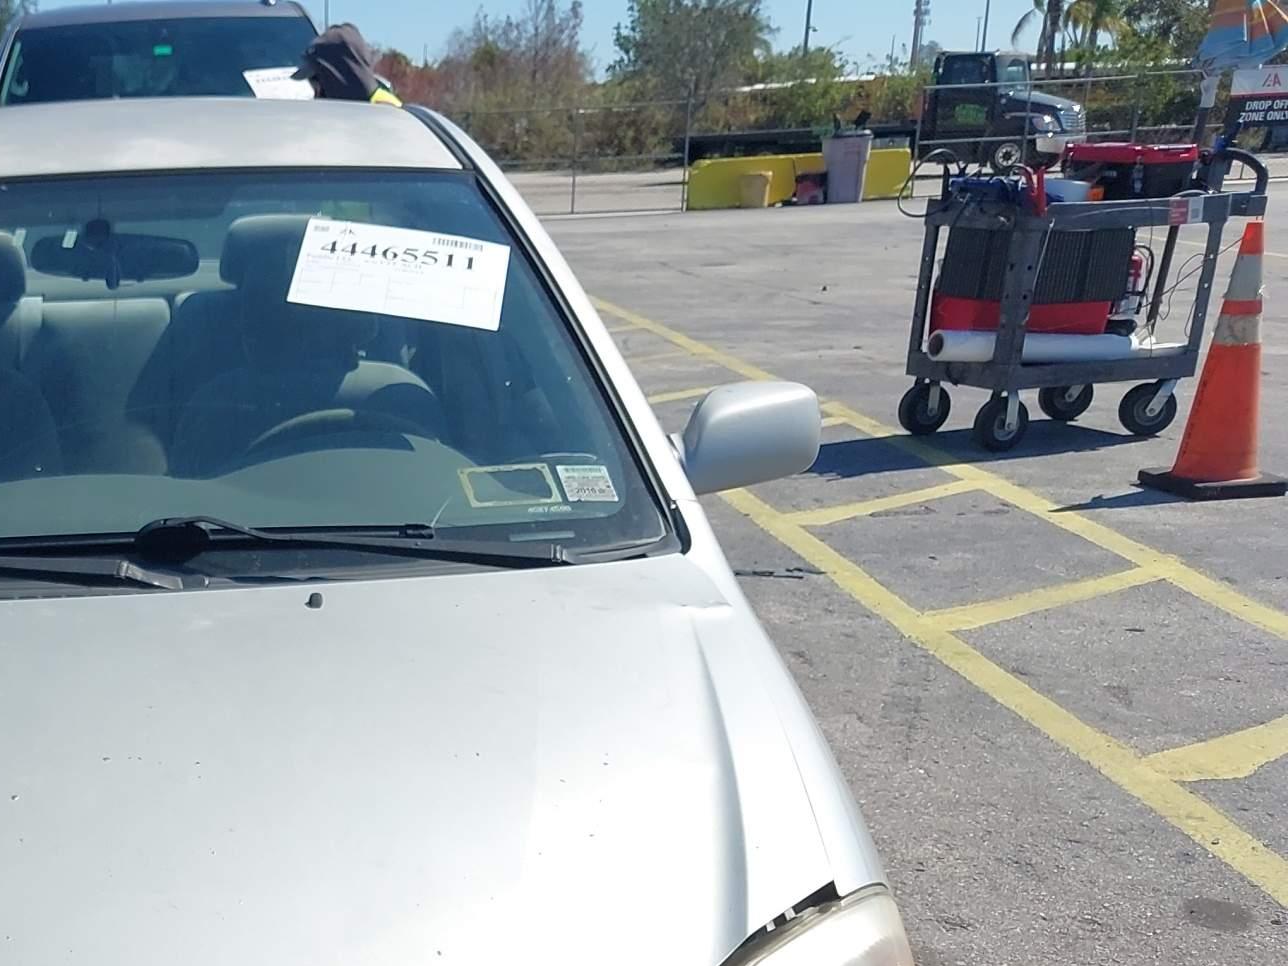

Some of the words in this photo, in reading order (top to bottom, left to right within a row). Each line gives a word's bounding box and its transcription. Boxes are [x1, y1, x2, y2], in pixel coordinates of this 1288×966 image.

[1245, 100, 1272, 110] DROP
[1238, 111, 1265, 122] ZONE
[320, 240, 474, 270] 44465511
